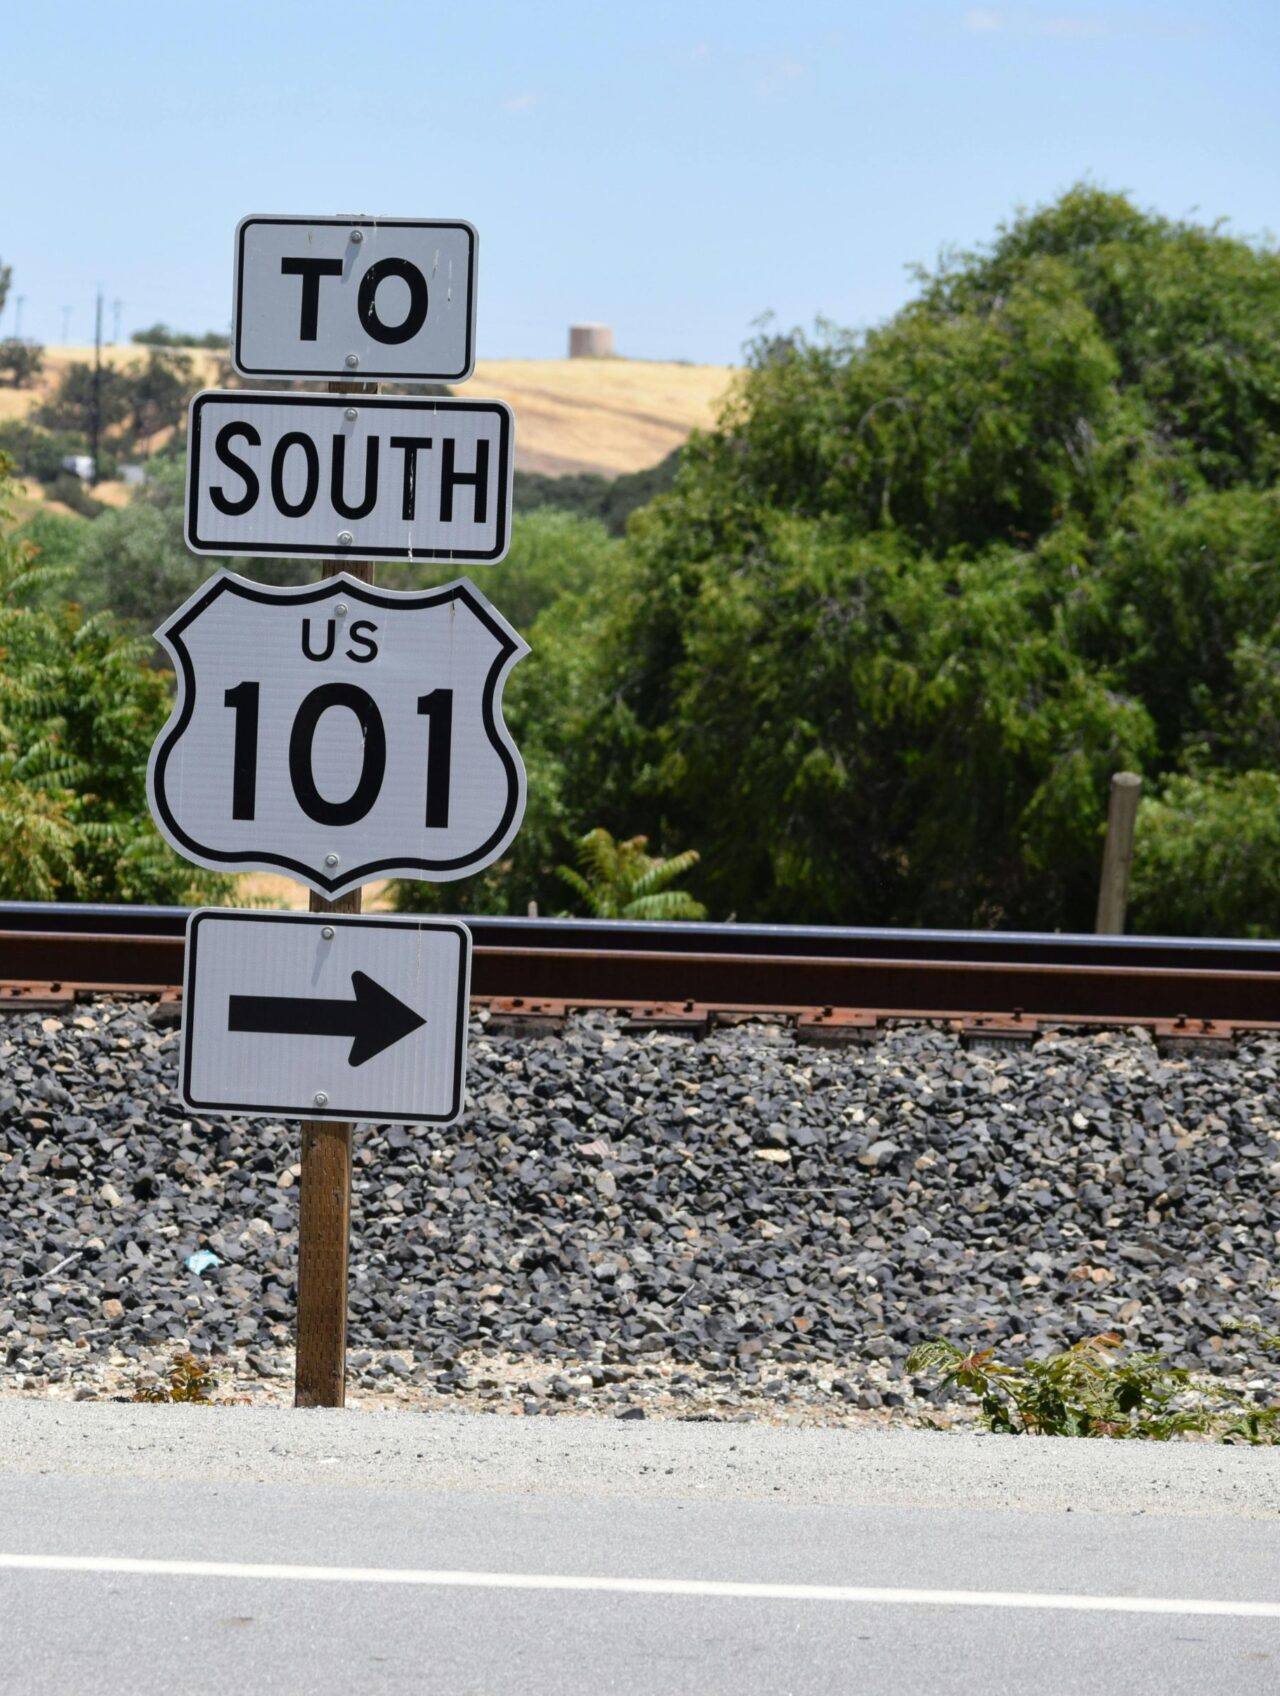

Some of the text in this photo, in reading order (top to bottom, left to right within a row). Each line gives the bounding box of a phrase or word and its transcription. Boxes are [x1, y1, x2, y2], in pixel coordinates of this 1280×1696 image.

[281, 257, 428, 345] TO
[209, 421, 490, 523] SOUTH
[301, 618, 379, 664] US
[224, 680, 454, 829] 101
